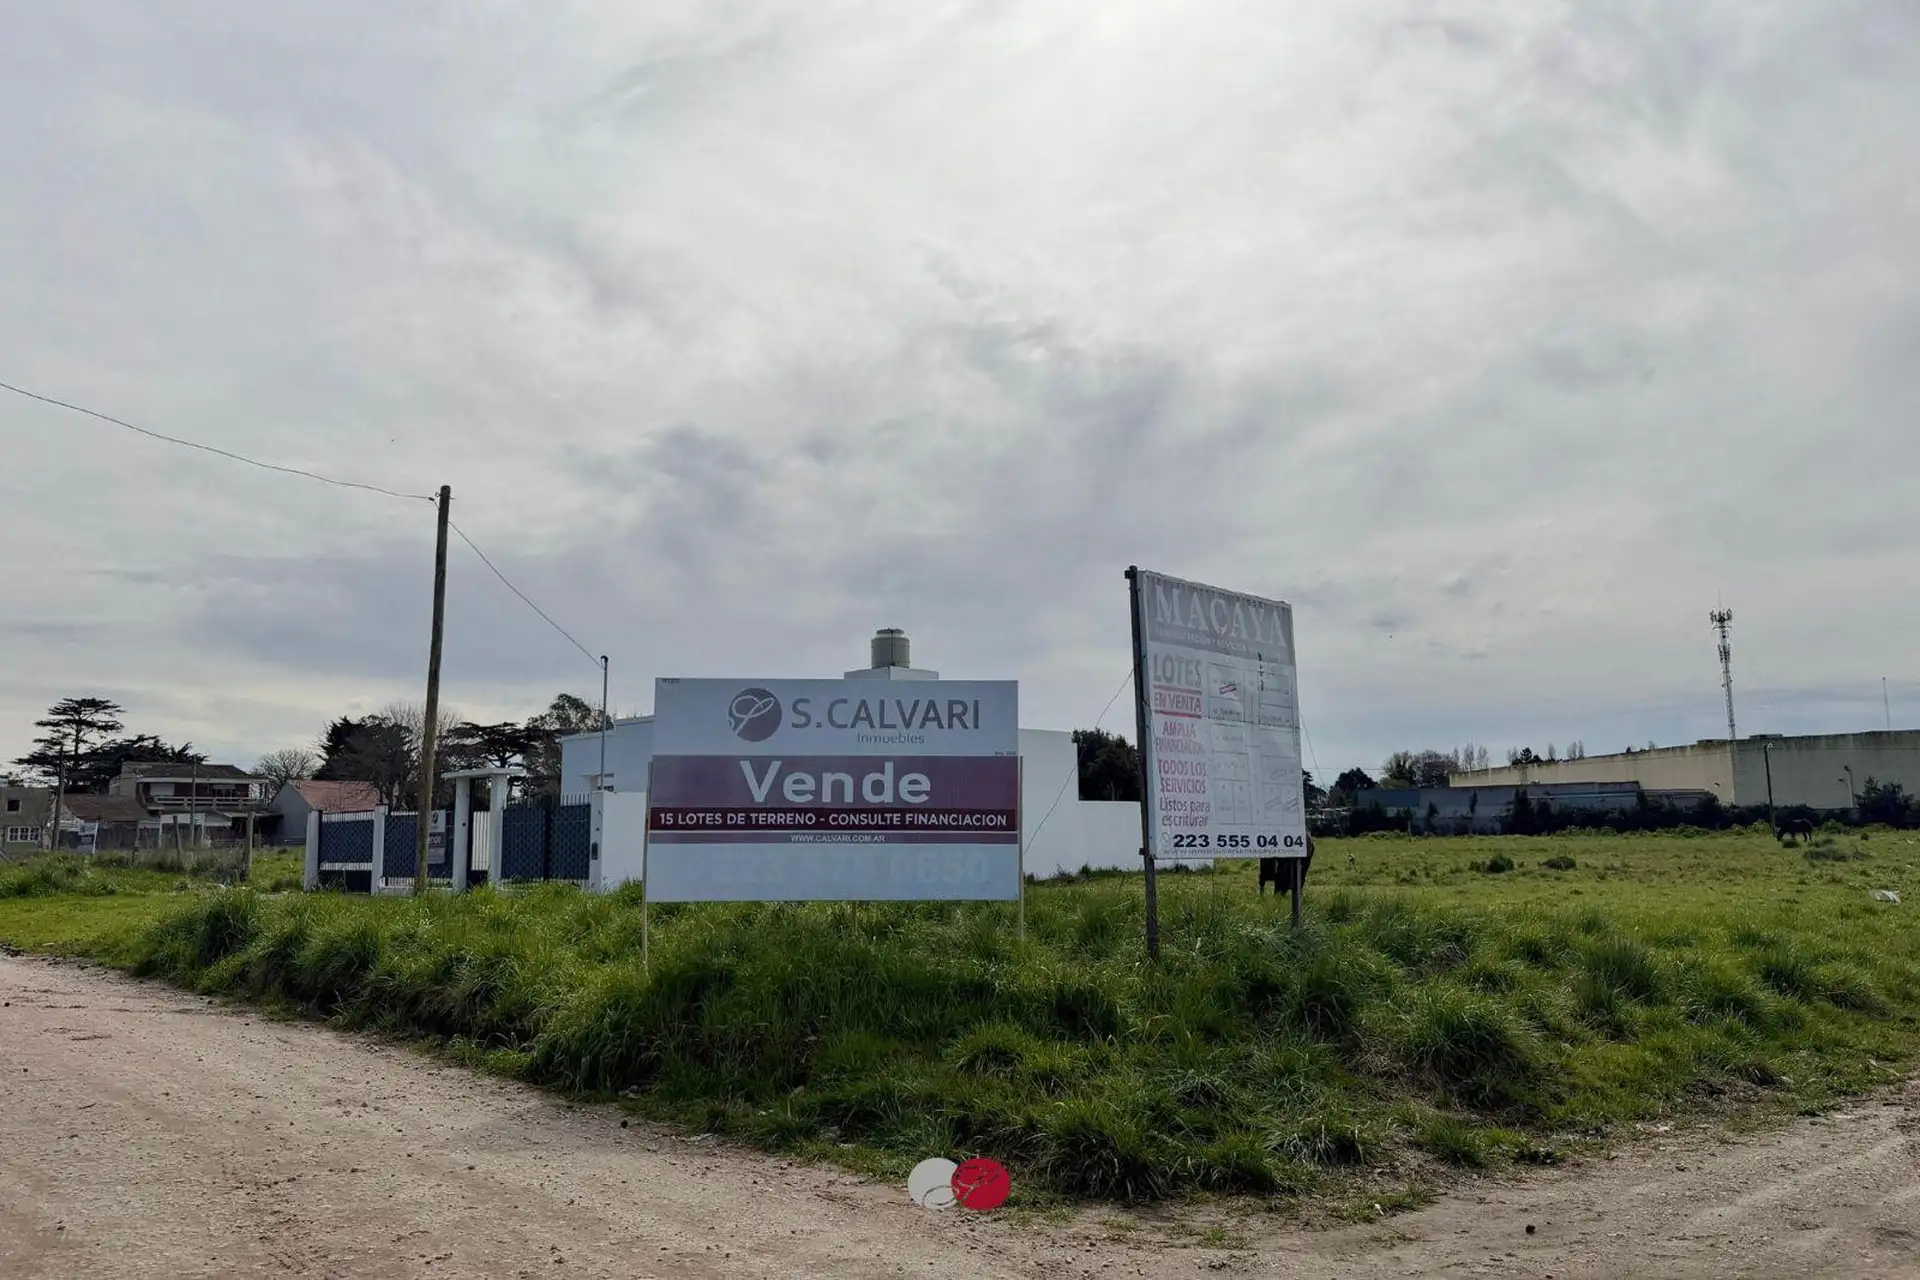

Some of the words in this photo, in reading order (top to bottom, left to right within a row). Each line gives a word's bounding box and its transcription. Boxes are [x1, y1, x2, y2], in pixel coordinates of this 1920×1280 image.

[1154, 584, 1288, 647] MACAYA
[1153, 653, 1202, 688] LOTES
[1154, 691, 1167, 708] EN
[1168, 692, 1202, 713] VENTA
[791, 698, 979, 730] S.CALVARI
[857, 732, 925, 744] Inmuebles
[1163, 721, 1196, 738] AMPLIA
[1158, 759, 1188, 776] TODOS
[1190, 761, 1207, 777] LOS
[740, 760, 931, 804] Vende
[1160, 776, 1206, 794] SERVICIOS
[1160, 797, 1187, 812] Listos
[1189, 801, 1211, 816] para
[659, 813, 673, 825] 15
[678, 813, 722, 825] LOTES
[727, 813, 745, 826] DE
[750, 813, 816, 826] TERRENO
[829, 813, 901, 826] CONSULTE
[905, 813, 1007, 827] FINANCIACION
[1162, 814, 1208, 827] escriturar
[790, 833, 886, 843] WWW.CALVARI.COM.AR
[1172, 833, 1210, 848] 223
[1217, 834, 1250, 848] 555
[1257, 835, 1279, 848] 04
[1284, 835, 1304, 848] 04
